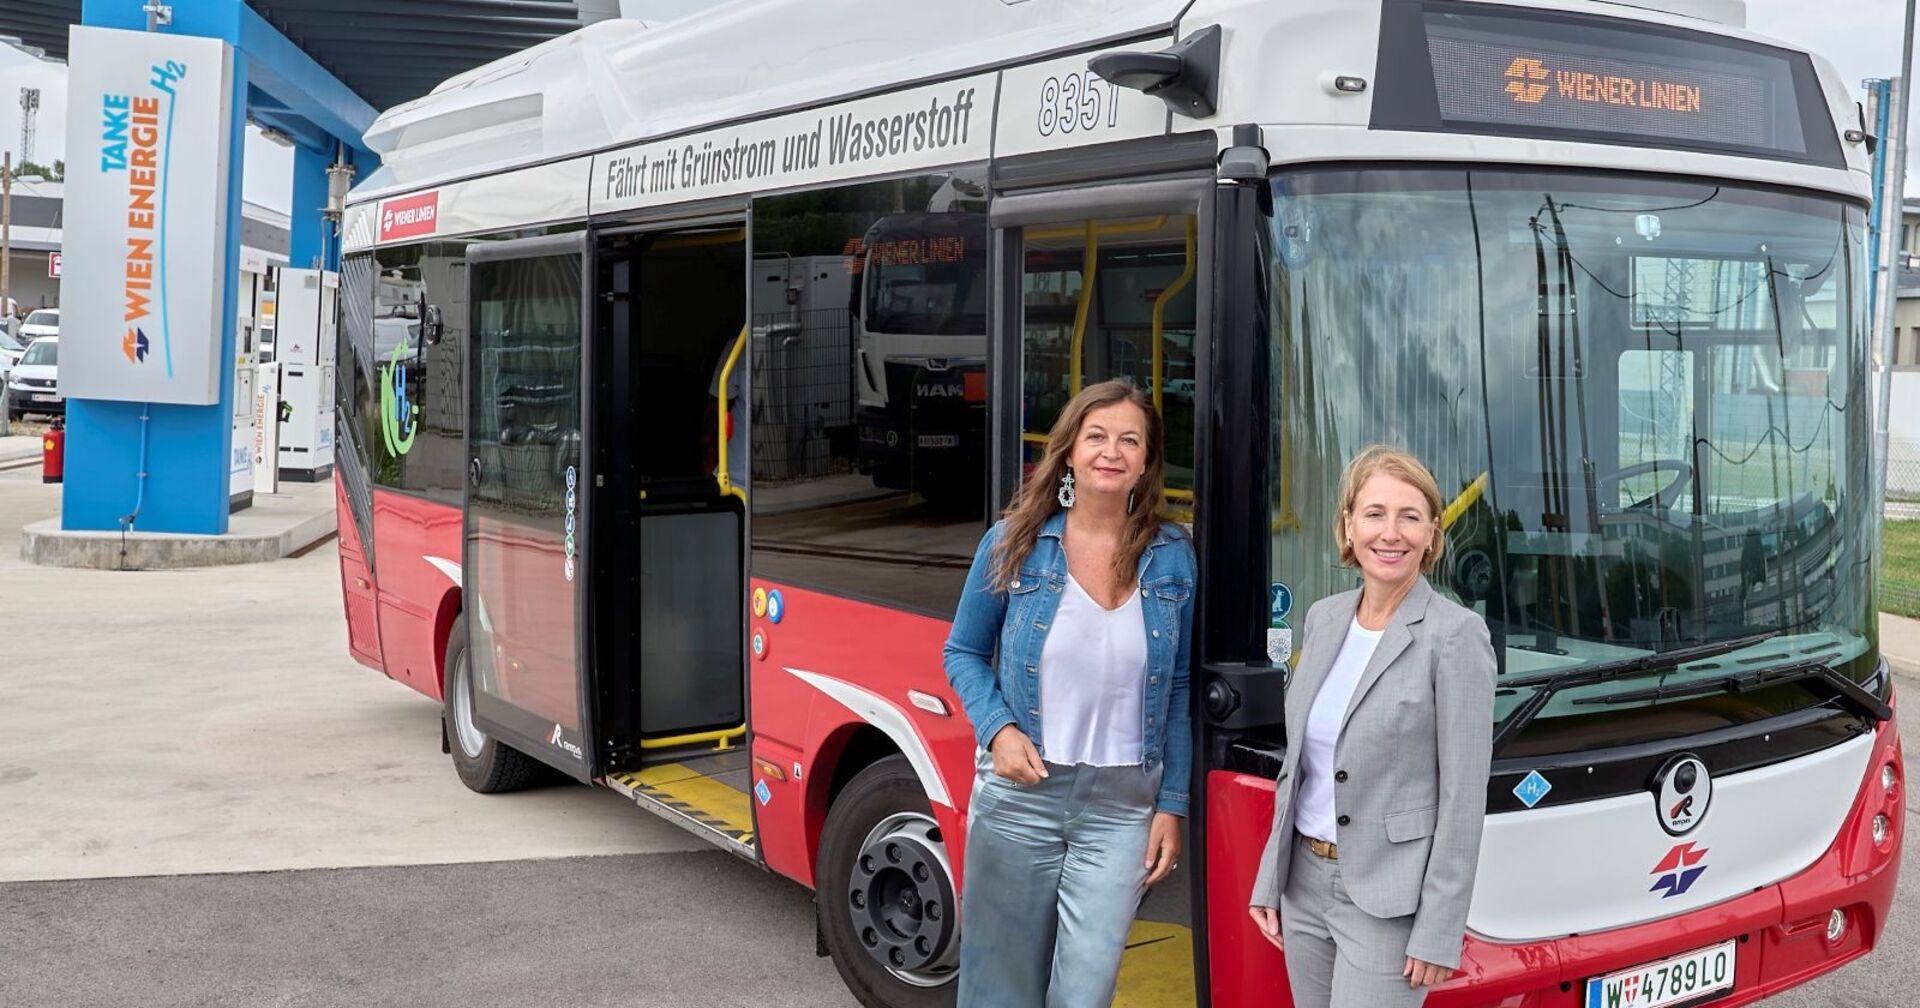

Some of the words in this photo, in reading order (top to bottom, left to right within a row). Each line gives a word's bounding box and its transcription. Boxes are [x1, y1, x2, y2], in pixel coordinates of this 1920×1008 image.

[1038, 68, 1119, 137] 8351
[1557, 70, 1637, 106] WIENER
[1639, 80, 1700, 112] LINIEN
[101, 94, 129, 173] TANKE
[128, 96, 159, 229] ENERGIE
[606, 154, 647, 200] Fährt
[650, 149, 677, 193] mit
[681, 139, 776, 189] Grünstrom
[782, 119, 823, 173] und
[829, 88, 975, 166] Wasserstoff
[124, 238, 153, 322] WIEN
[921, 235, 965, 263] LINIEN
[1607, 979, 1623, 1008] W
